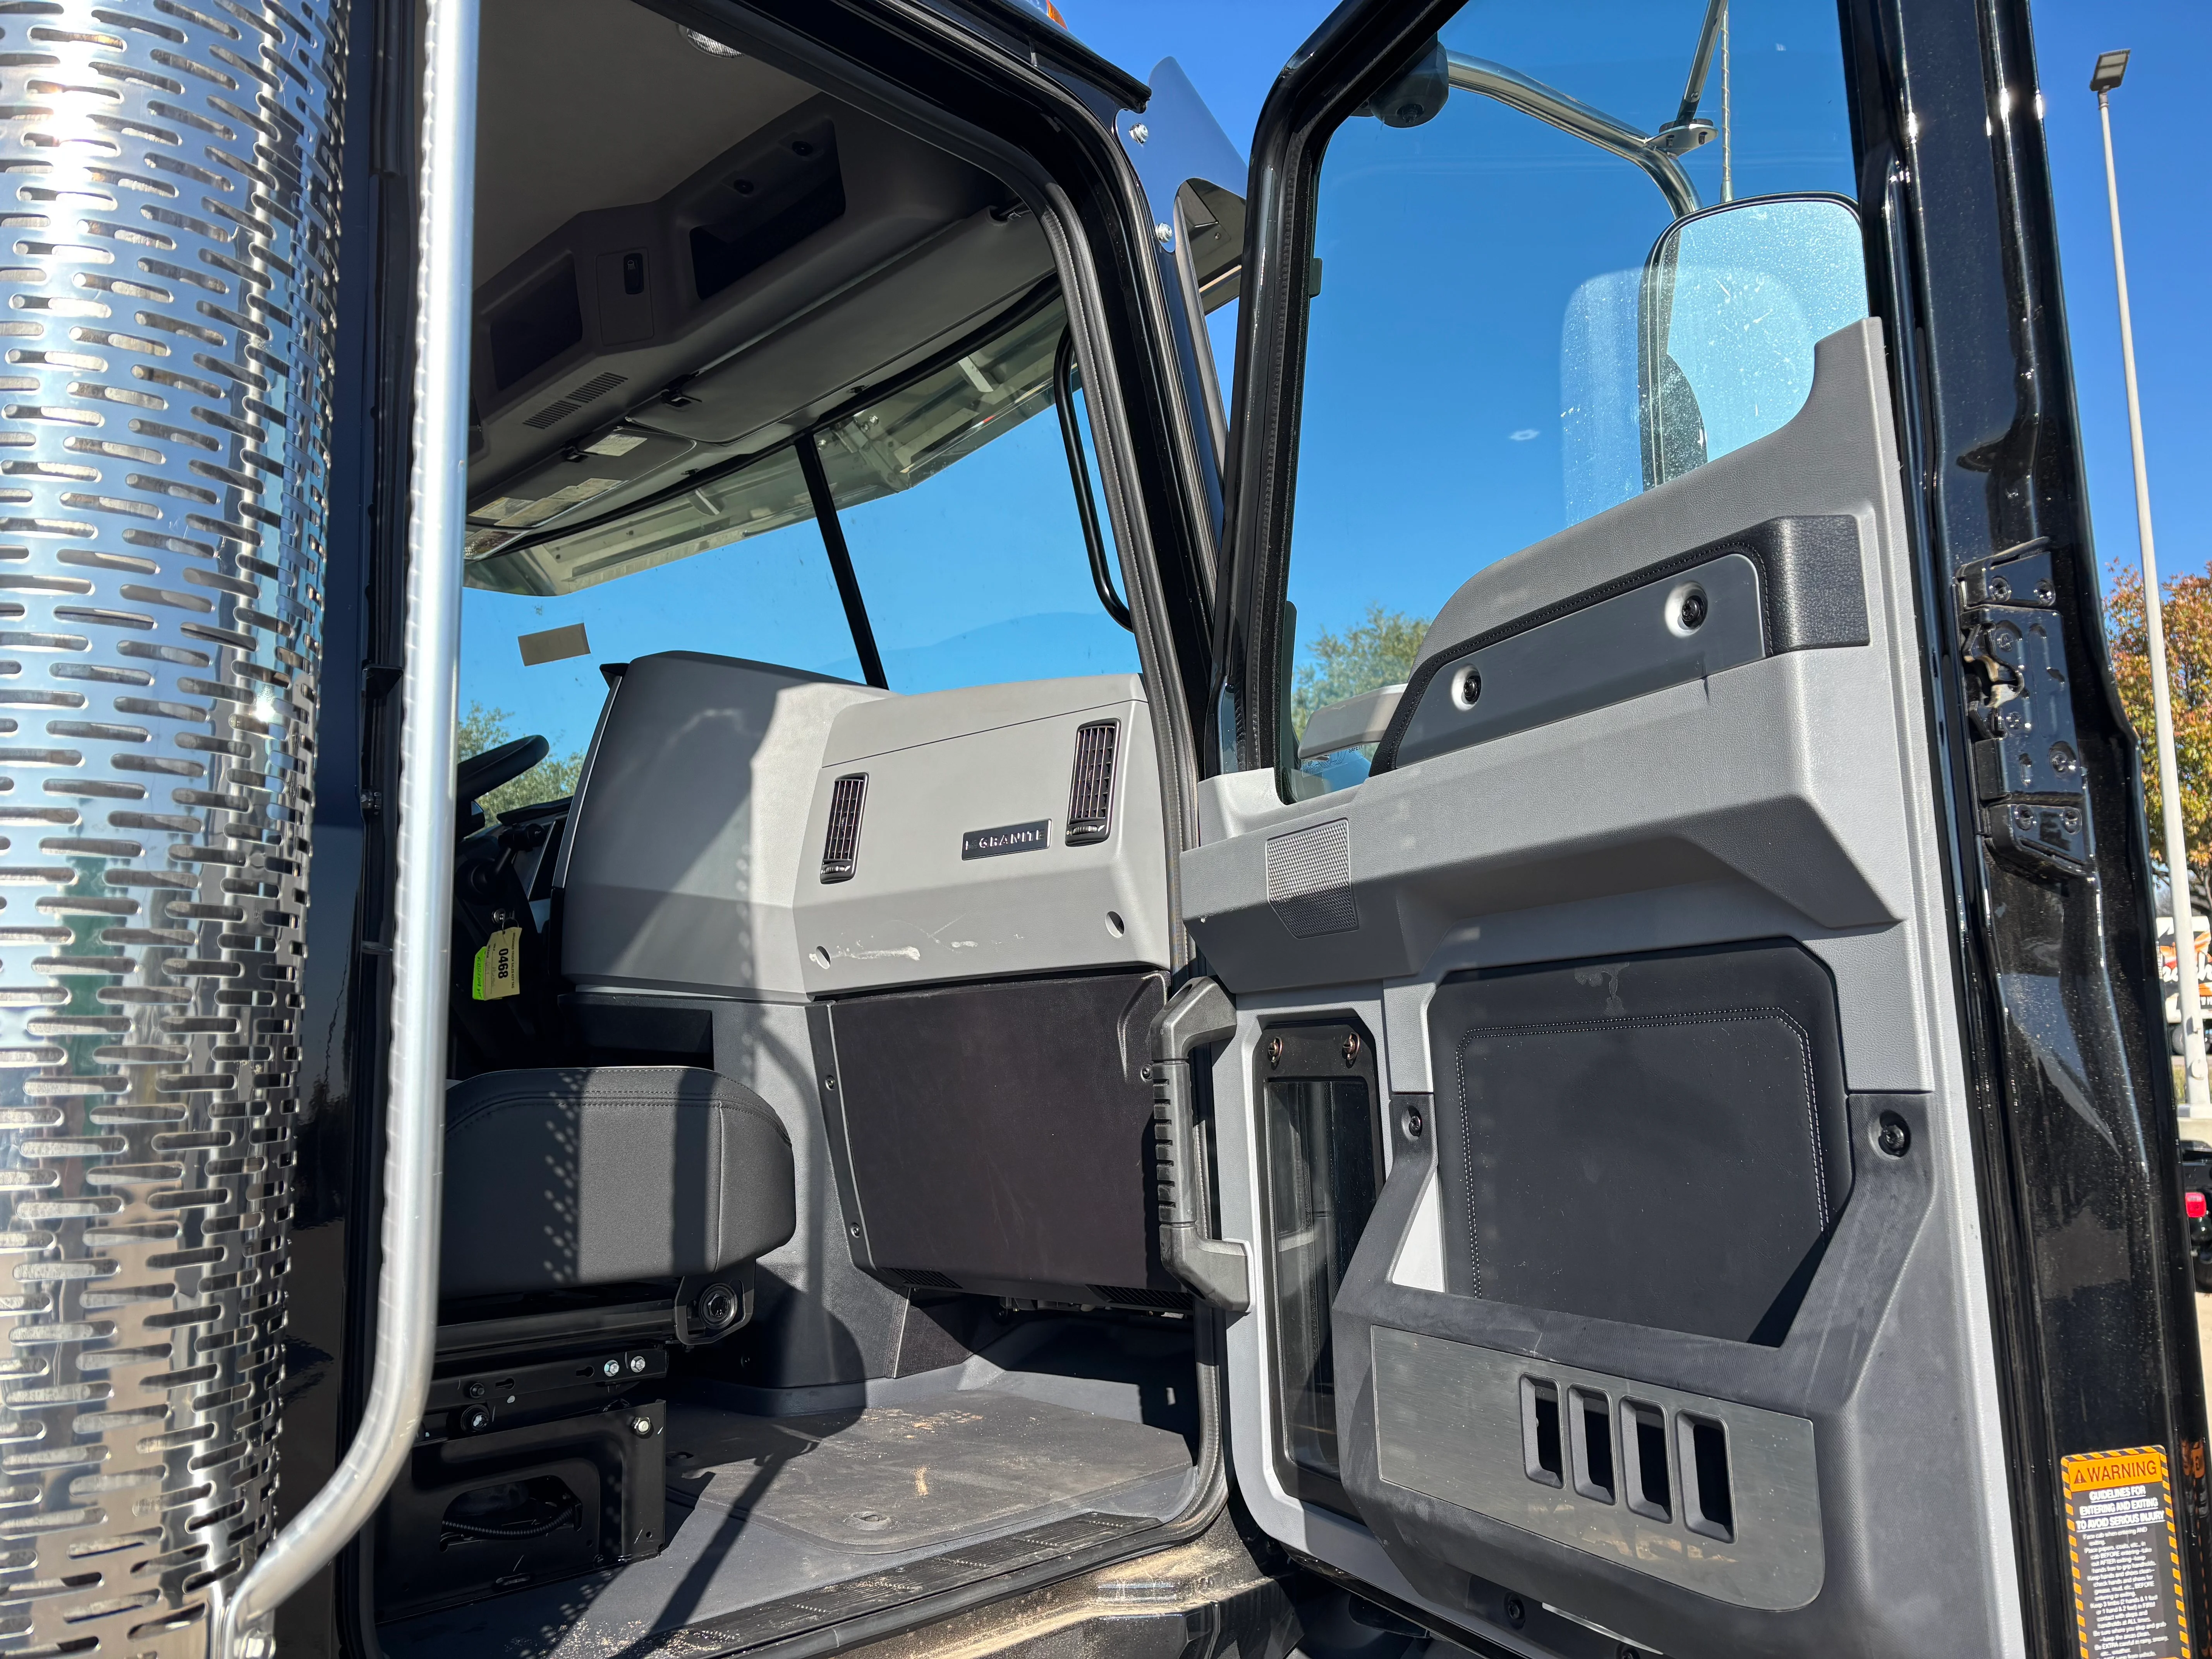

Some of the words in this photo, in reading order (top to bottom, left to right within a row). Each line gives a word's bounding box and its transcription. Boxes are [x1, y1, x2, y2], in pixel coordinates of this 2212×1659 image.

[979, 829, 1044, 848] GRANITE
[498, 948, 508, 979] 0468
[2087, 1460, 2157, 1482] WARNING
[2089, 1487, 2130, 1501] GUIDELINES
[2131, 1486, 2146, 1495] FOR
[2080, 1503, 2116, 1516] ENTERING
[2116, 1501, 2130, 1511] AND
[2131, 1498, 2159, 1509] EXITING
[2076, 1520, 2087, 1530] TO
[2088, 1517, 2109, 1528] AVOID
[2110, 1514, 2139, 1526] SERIOUS
[2140, 1510, 2164, 1522] INJURY
[2135, 1581, 2155, 1589] BEFORE
